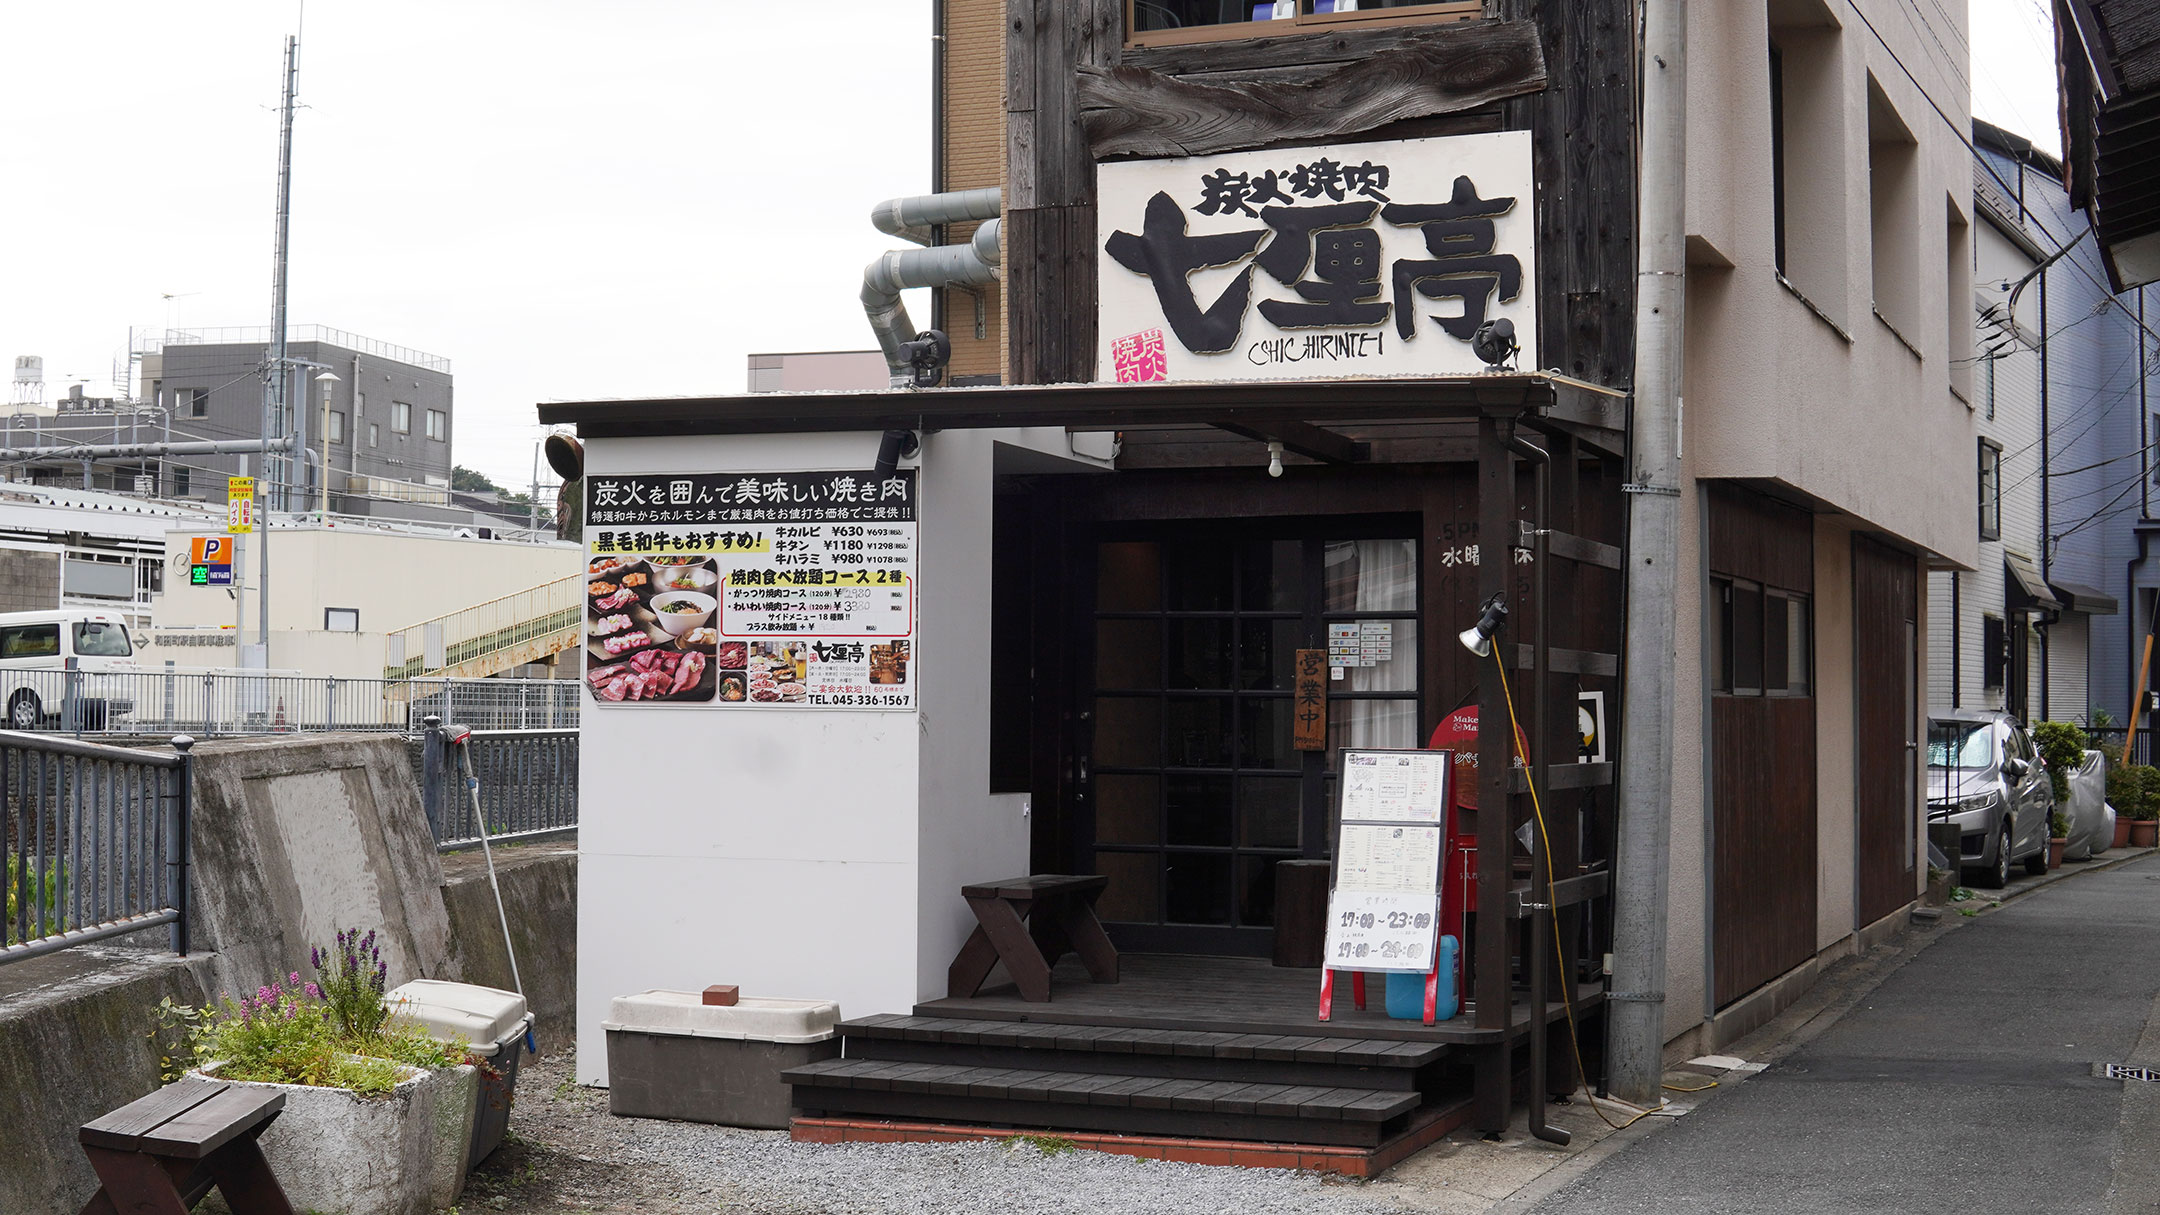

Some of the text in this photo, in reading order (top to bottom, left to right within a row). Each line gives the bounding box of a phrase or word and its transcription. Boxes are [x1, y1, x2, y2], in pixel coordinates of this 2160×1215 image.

[1192, 157, 1391, 219] 炭火焼肉
[594, 476, 908, 507] 炭火を囲んで美味しい焼き肉
[231, 501, 239, 525] バイク
[776, 526, 821, 538] 牛カルビ
[832, 526, 864, 537] ¥630
[202, 538, 221, 561] P
[597, 531, 763, 552] 黒毛和牛もおすすめ!
[776, 539, 810, 552] 牛タン
[824, 539, 864, 551] ¥1180
[776, 553, 820, 565] 牛ハラミ
[832, 553, 864, 564] ¥980
[192, 566, 208, 583] 空
[155, 634, 236, 647] 和田町駅自転車駐車
[808, 694, 910, 706] TEL.045-336-1567
[1298, 653, 1324, 733] 営業中
[1453, 715, 1479, 723] Make
